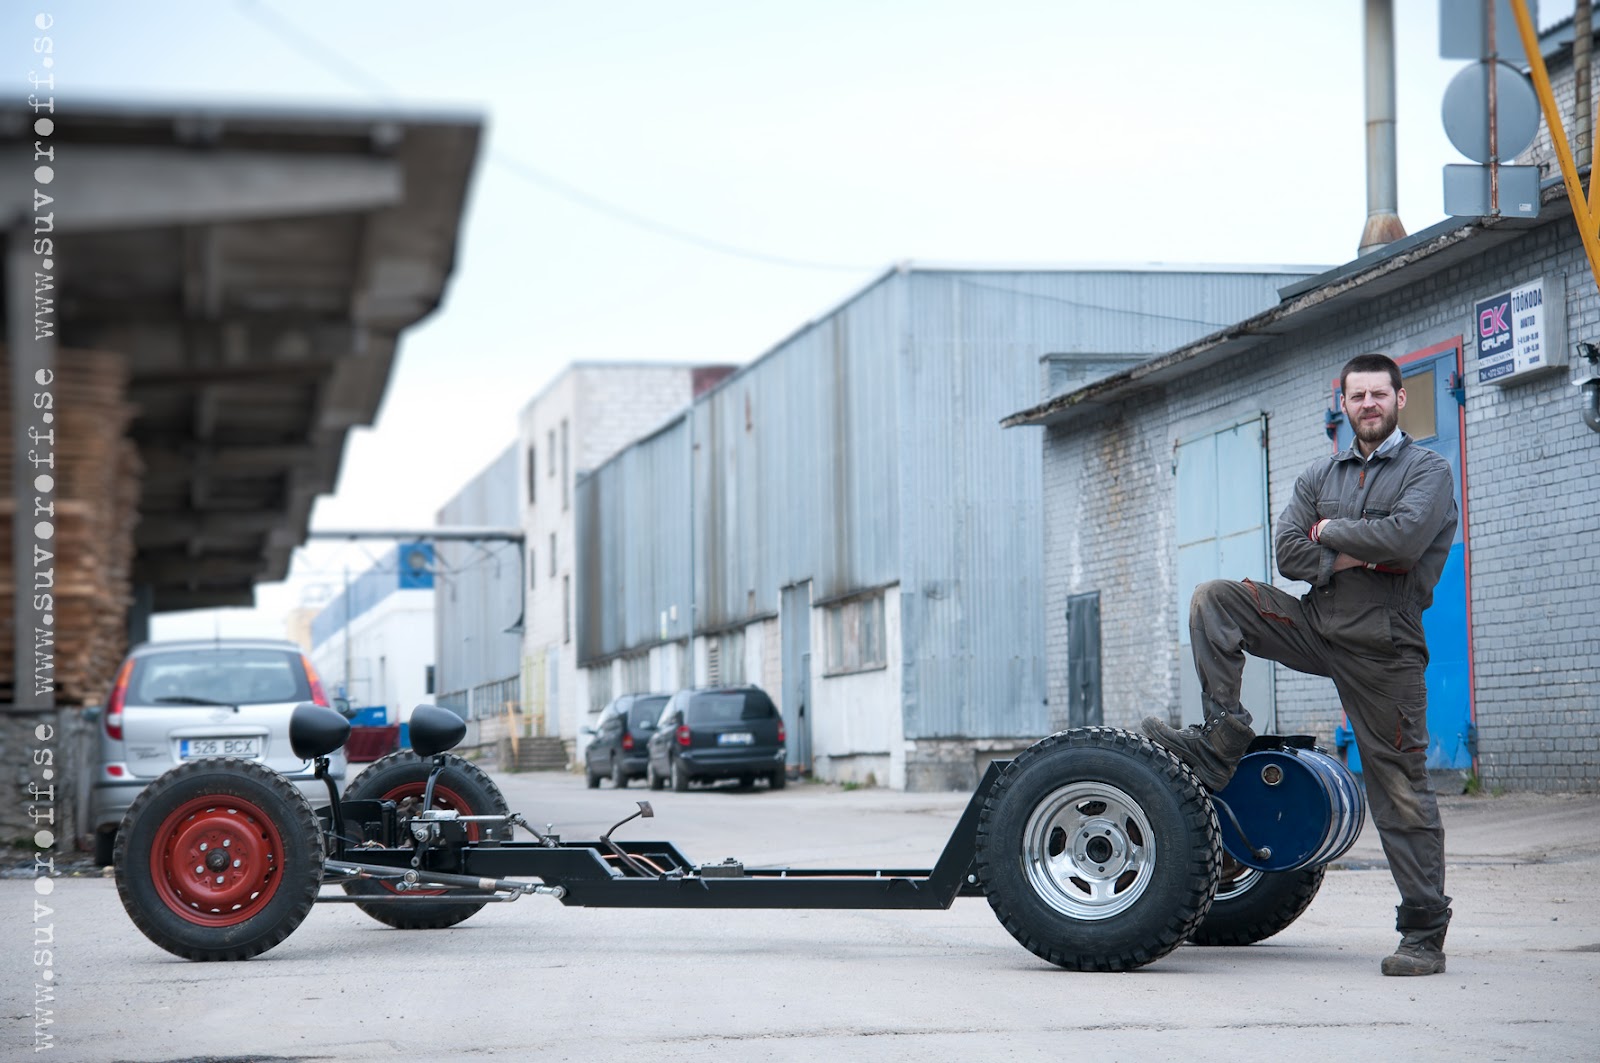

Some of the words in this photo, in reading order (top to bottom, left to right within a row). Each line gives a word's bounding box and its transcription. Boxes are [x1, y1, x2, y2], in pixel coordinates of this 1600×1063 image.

[1480, 302, 1509, 338] OK
[1481, 332, 1510, 351] GRUPP
[193, 741, 217, 754] 526
[224, 740, 252, 753] BCX
